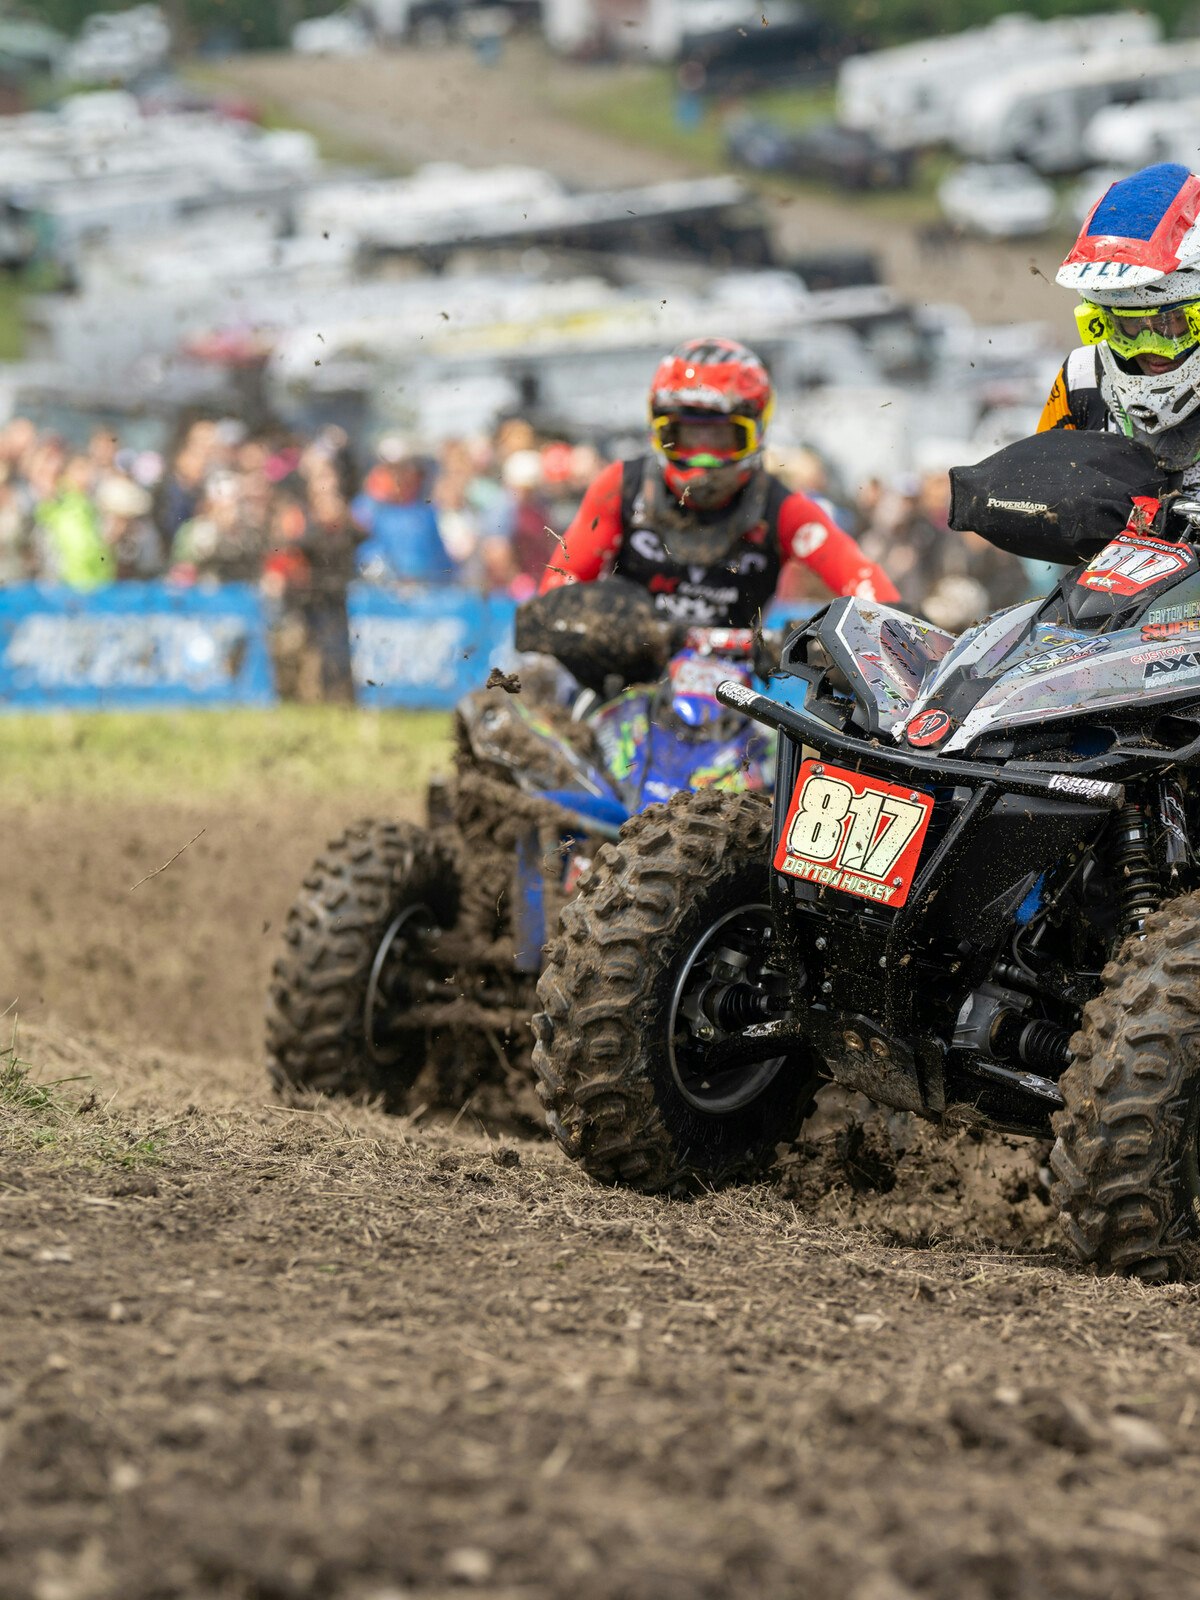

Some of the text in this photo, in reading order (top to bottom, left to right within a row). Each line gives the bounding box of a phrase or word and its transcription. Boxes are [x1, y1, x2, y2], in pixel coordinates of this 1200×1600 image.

[1077, 263, 1132, 279] FLY
[1086, 545, 1183, 584] 817
[1130, 645, 1186, 664] CUSTOM
[788, 775, 928, 882] 817
[782, 854, 896, 903] DAYTON HICKEY
